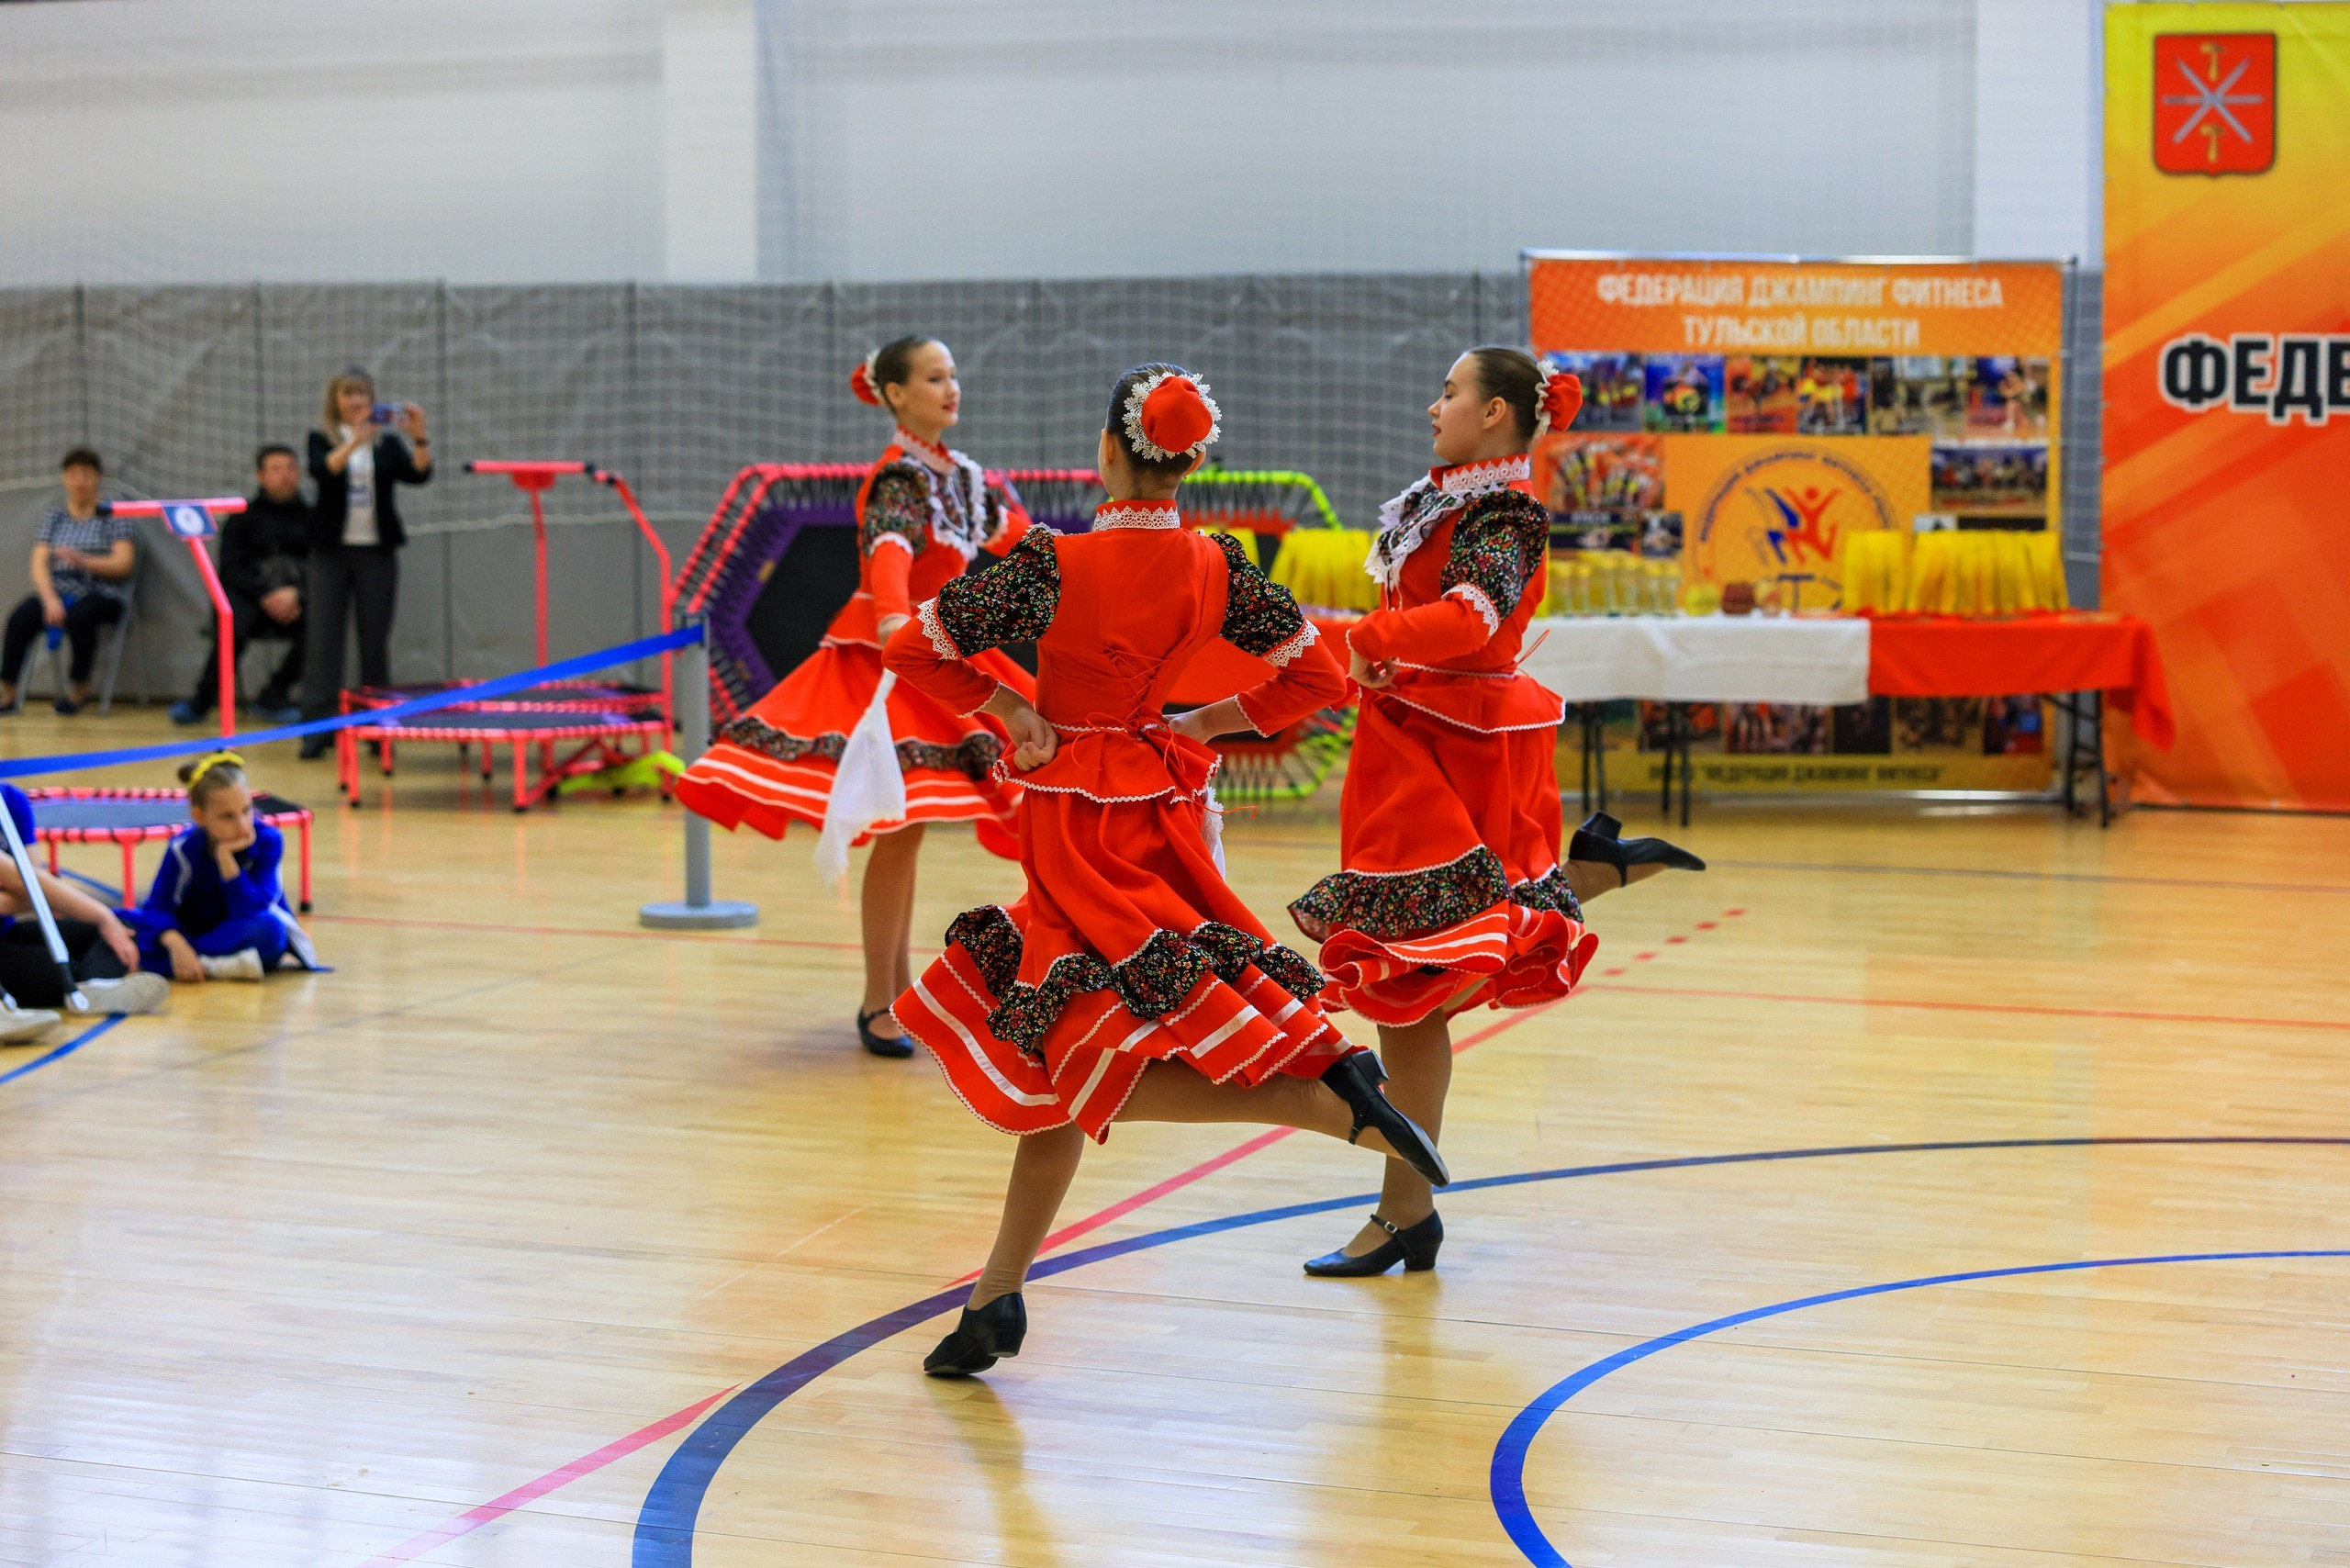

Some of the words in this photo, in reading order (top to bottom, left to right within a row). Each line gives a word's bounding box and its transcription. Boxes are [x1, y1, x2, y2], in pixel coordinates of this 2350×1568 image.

[1596, 275, 1743, 307] ФЕДЕРАЦИЯ
[1747, 277, 1888, 308] ДЖАМПИНГ
[1891, 277, 2003, 308] ФИТНЕСА
[1683, 313, 1807, 347] ТУЛЬСКОЙ
[1811, 317, 1919, 347] ОБЛАСТИ
